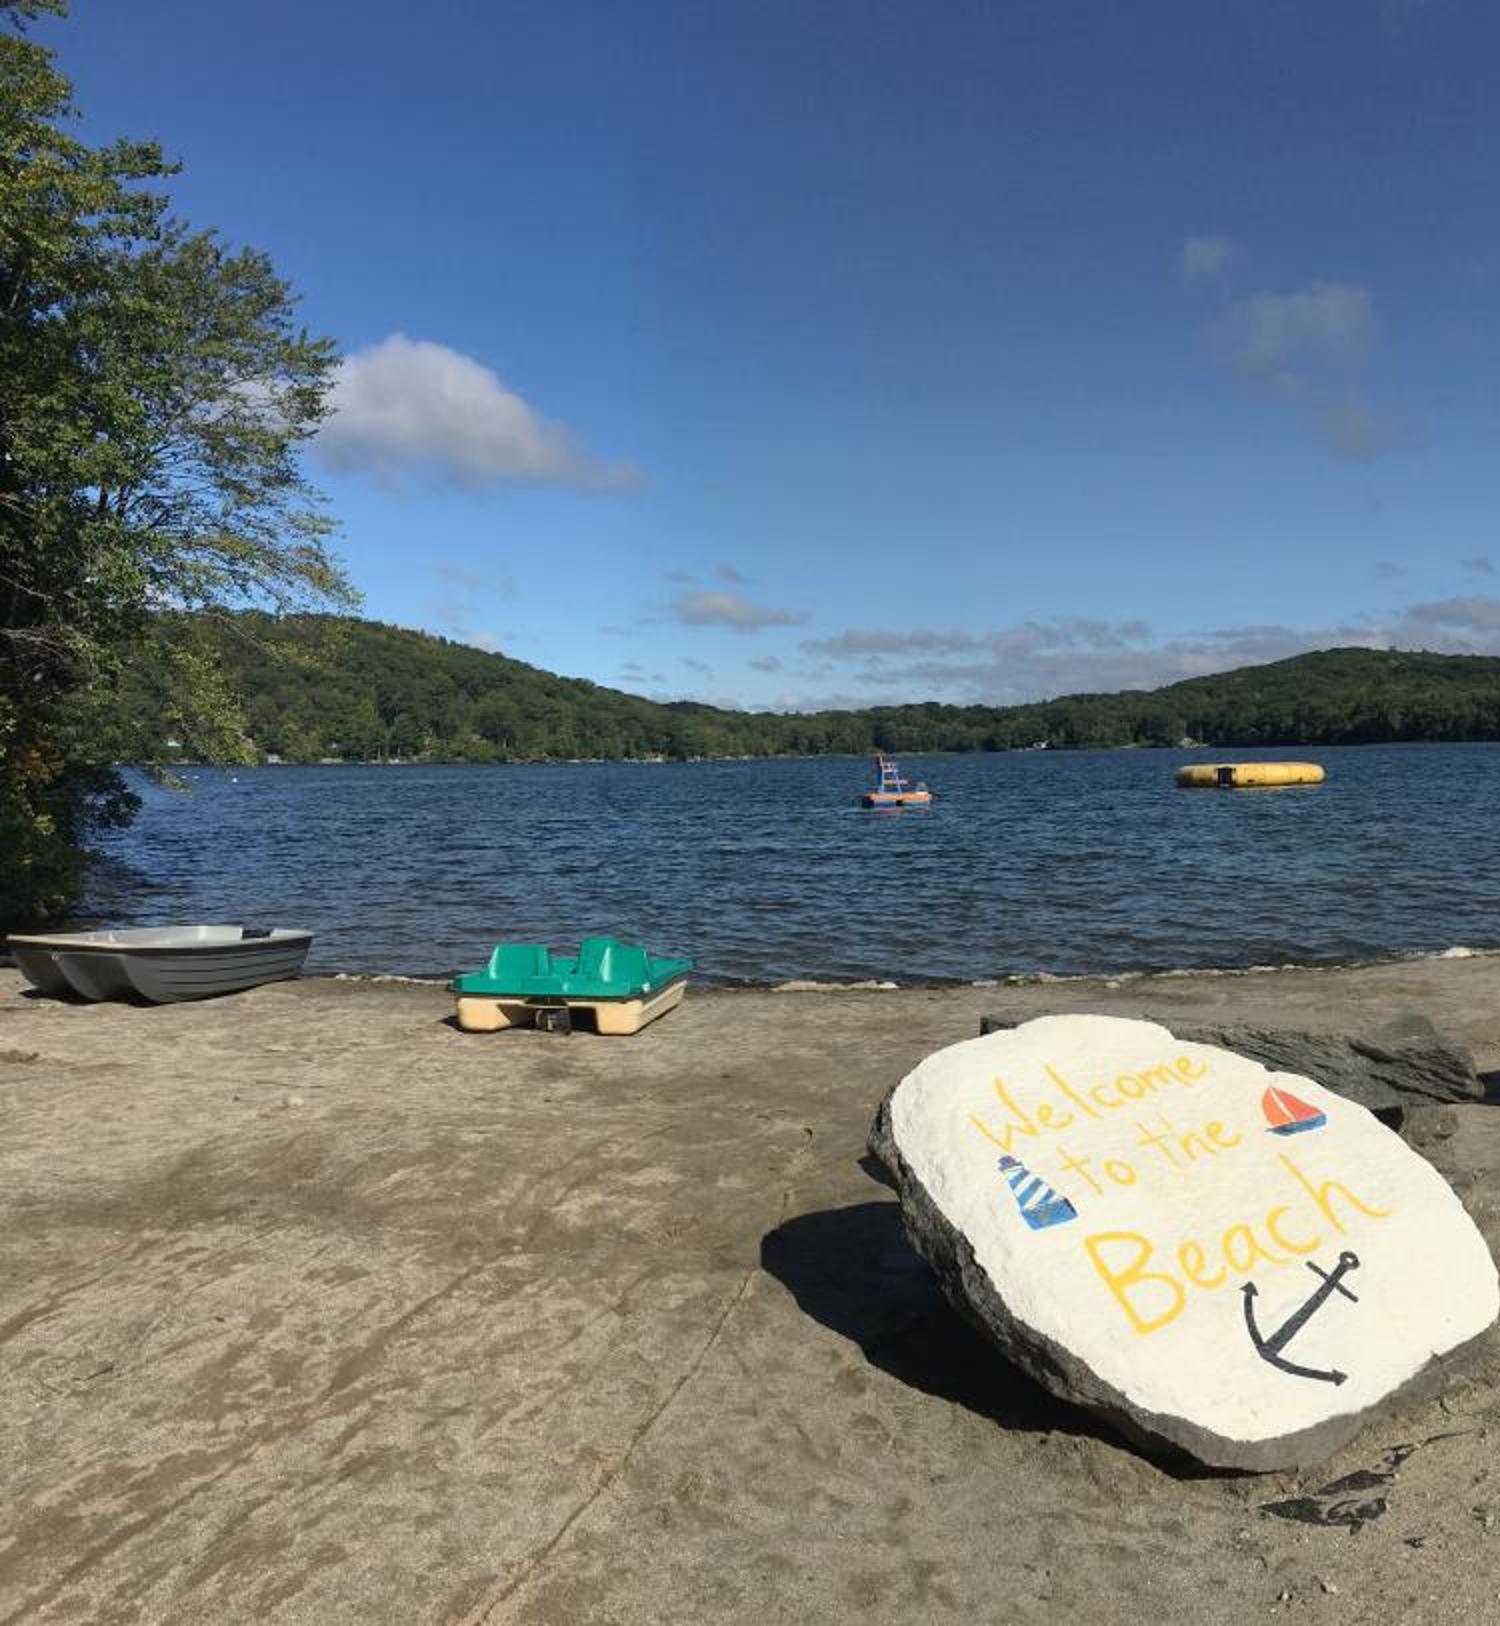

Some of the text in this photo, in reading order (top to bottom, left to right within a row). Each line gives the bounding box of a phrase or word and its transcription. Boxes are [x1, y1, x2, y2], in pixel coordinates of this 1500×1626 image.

[973, 1054, 1209, 1152] Welcome
[1059, 1115, 1243, 1196] to the
[1083, 1152, 1392, 1335] Beach
